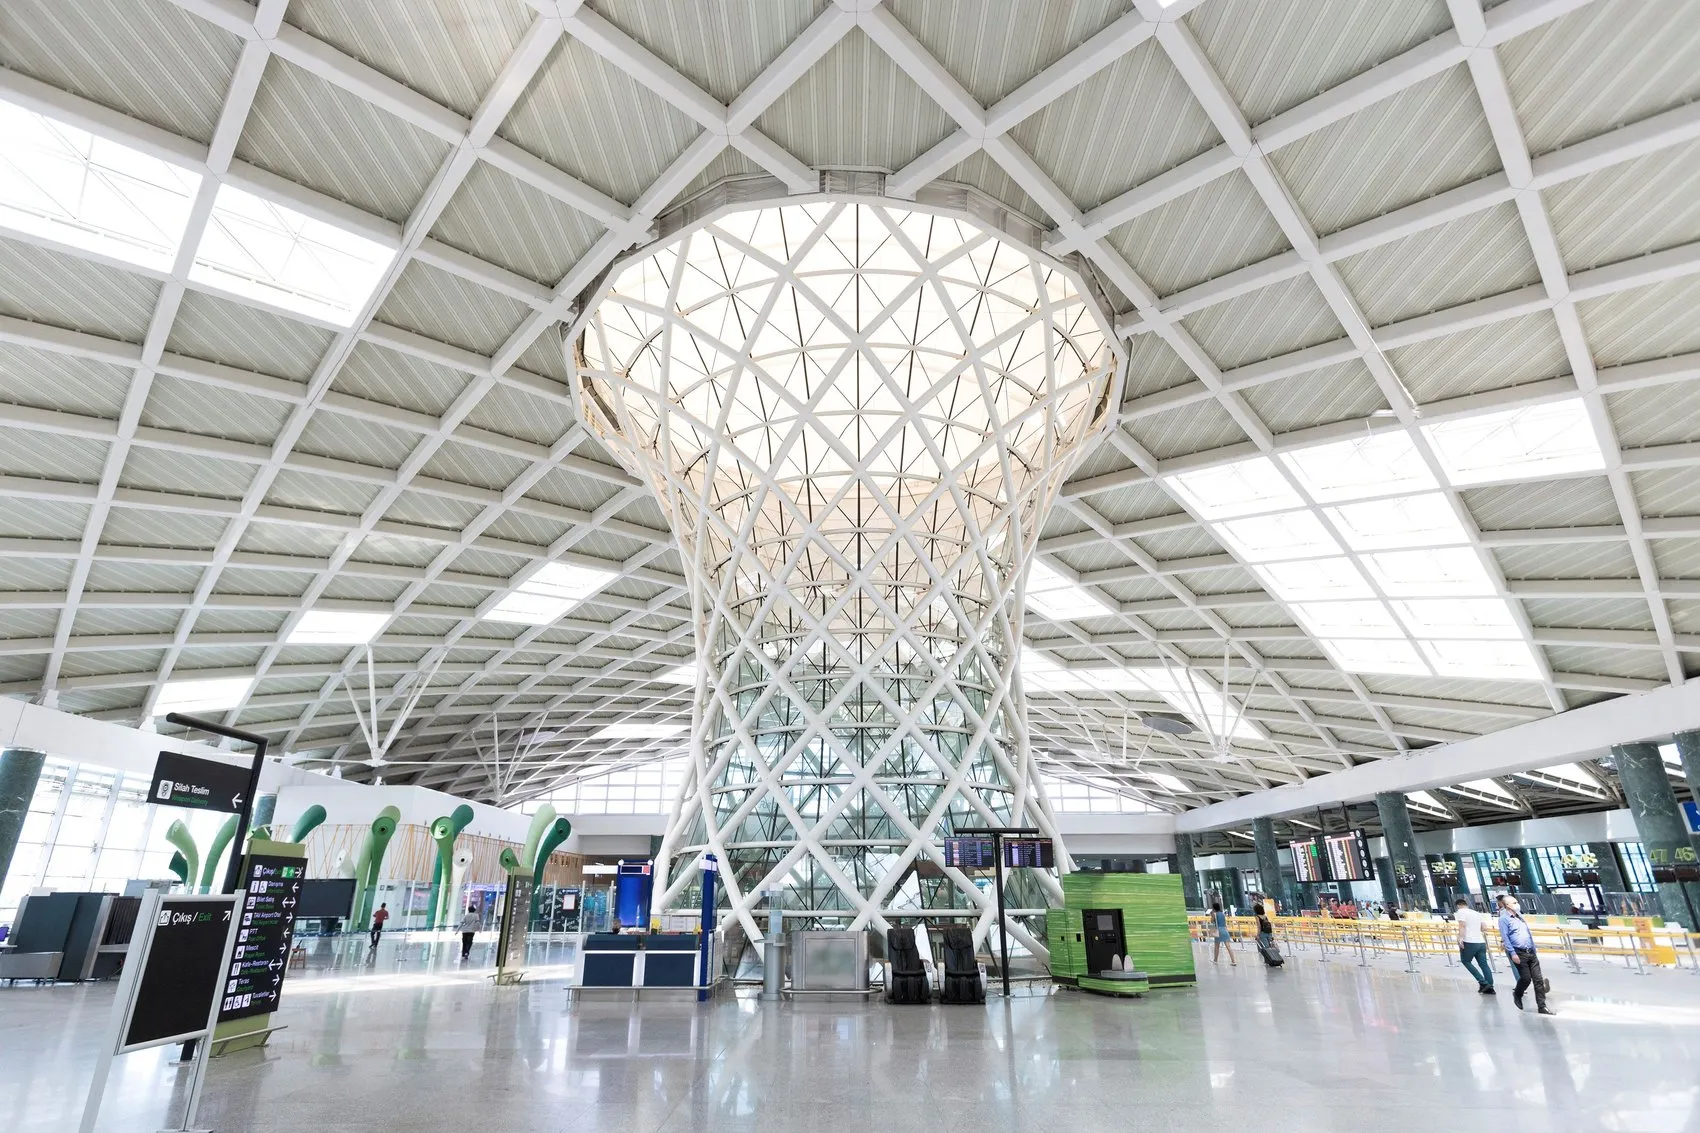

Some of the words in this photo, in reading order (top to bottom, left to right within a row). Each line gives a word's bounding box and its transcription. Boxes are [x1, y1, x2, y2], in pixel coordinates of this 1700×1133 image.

[174, 782, 190, 793] Silah
[191, 785, 210, 796] Teslim
[172, 912, 193, 926] Çıkış
[198, 912, 212, 922] Exit
